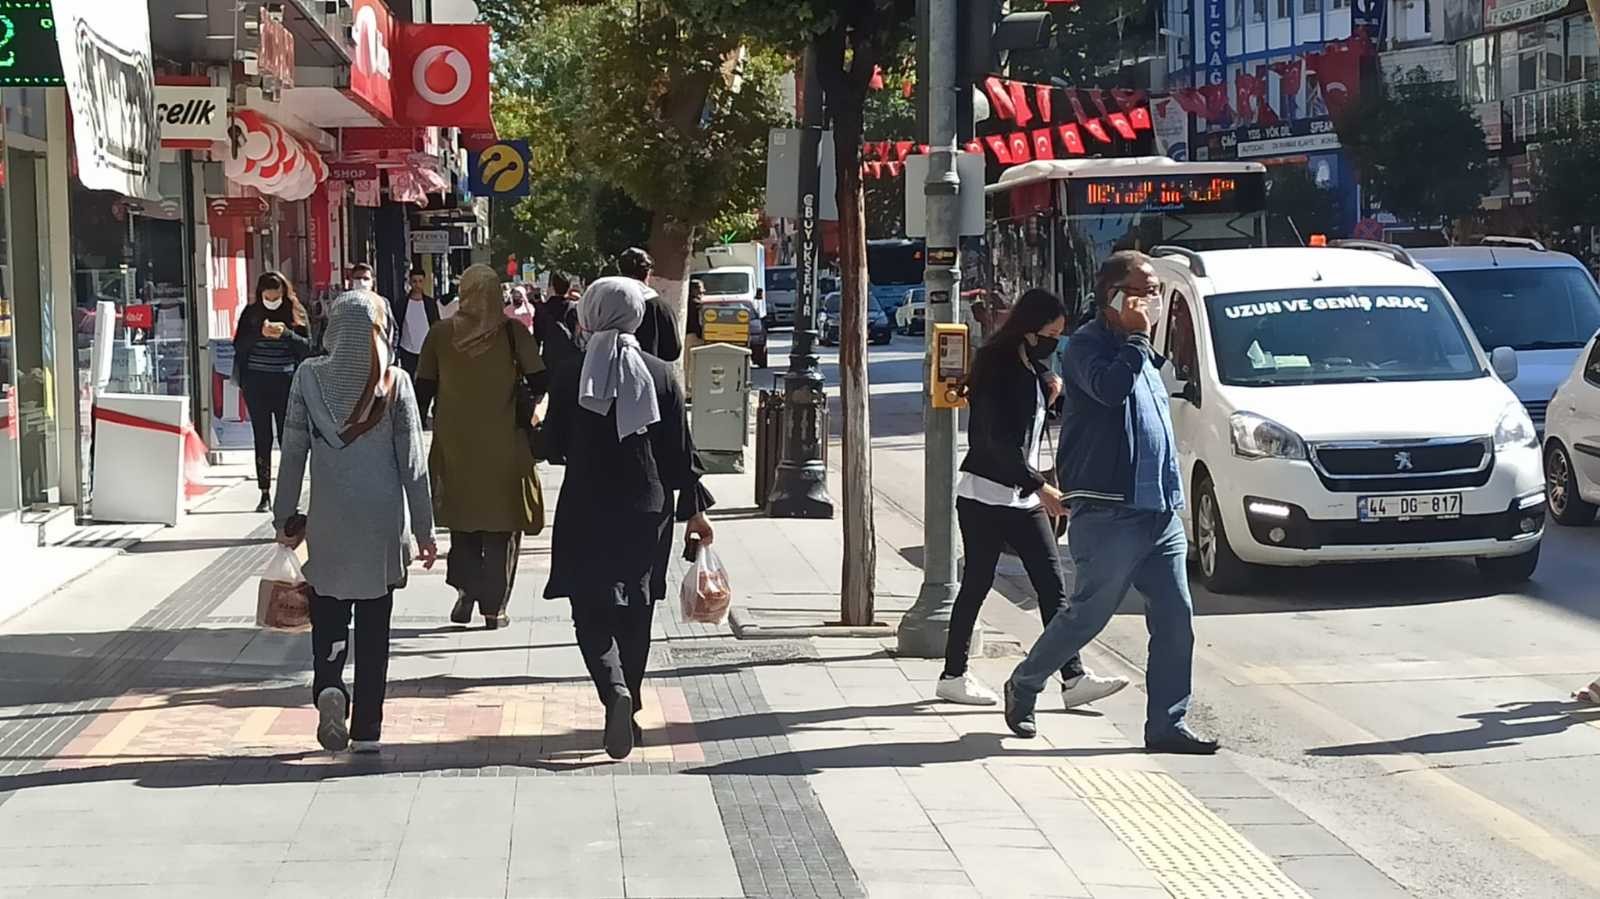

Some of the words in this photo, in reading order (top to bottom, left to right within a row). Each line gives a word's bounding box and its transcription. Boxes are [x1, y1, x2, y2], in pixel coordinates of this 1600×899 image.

[1208, 0, 1223, 86] L-ÇAĞ
[1225, 300, 1282, 319] UZUN
[1282, 299, 1312, 312] VE
[1313, 294, 1372, 312] GENİŞ
[1375, 296, 1429, 312] ARAÇ
[1369, 498, 1386, 516] 44
[1400, 497, 1418, 514] DG
[1431, 495, 1458, 513] 817
